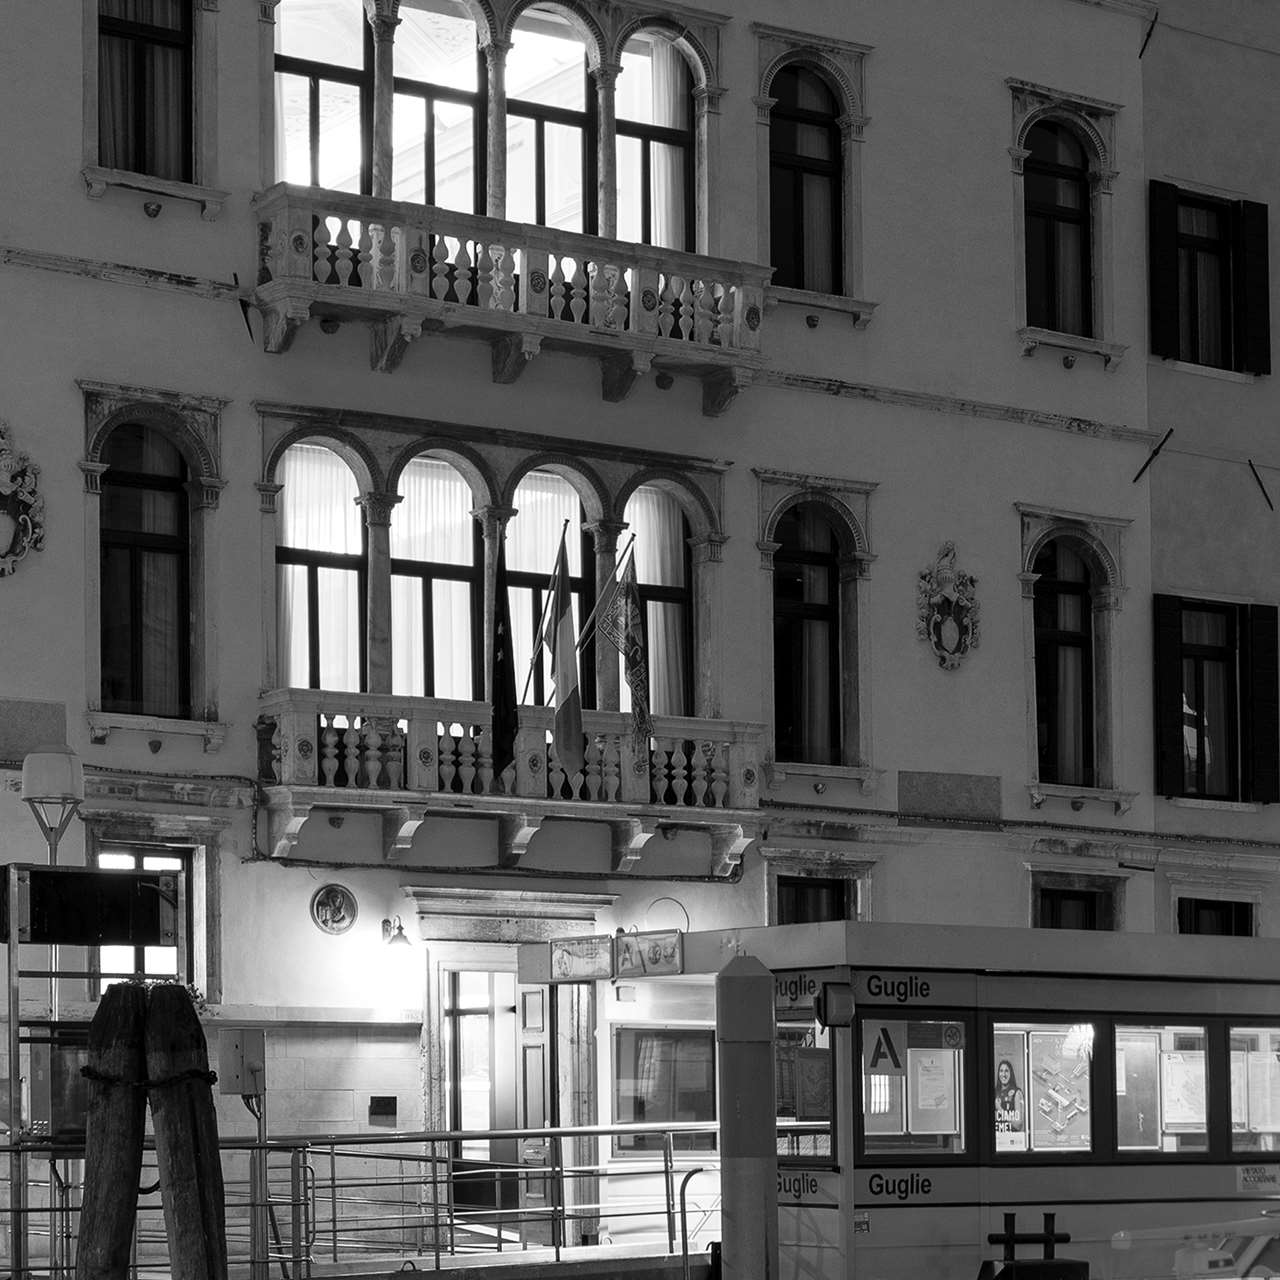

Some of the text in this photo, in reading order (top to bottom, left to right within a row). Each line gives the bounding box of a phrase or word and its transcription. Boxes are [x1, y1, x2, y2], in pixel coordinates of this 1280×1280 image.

[867, 974, 930, 1003] Guglie
[870, 1027, 902, 1069] A
[869, 1172, 932, 1201] Guglie
